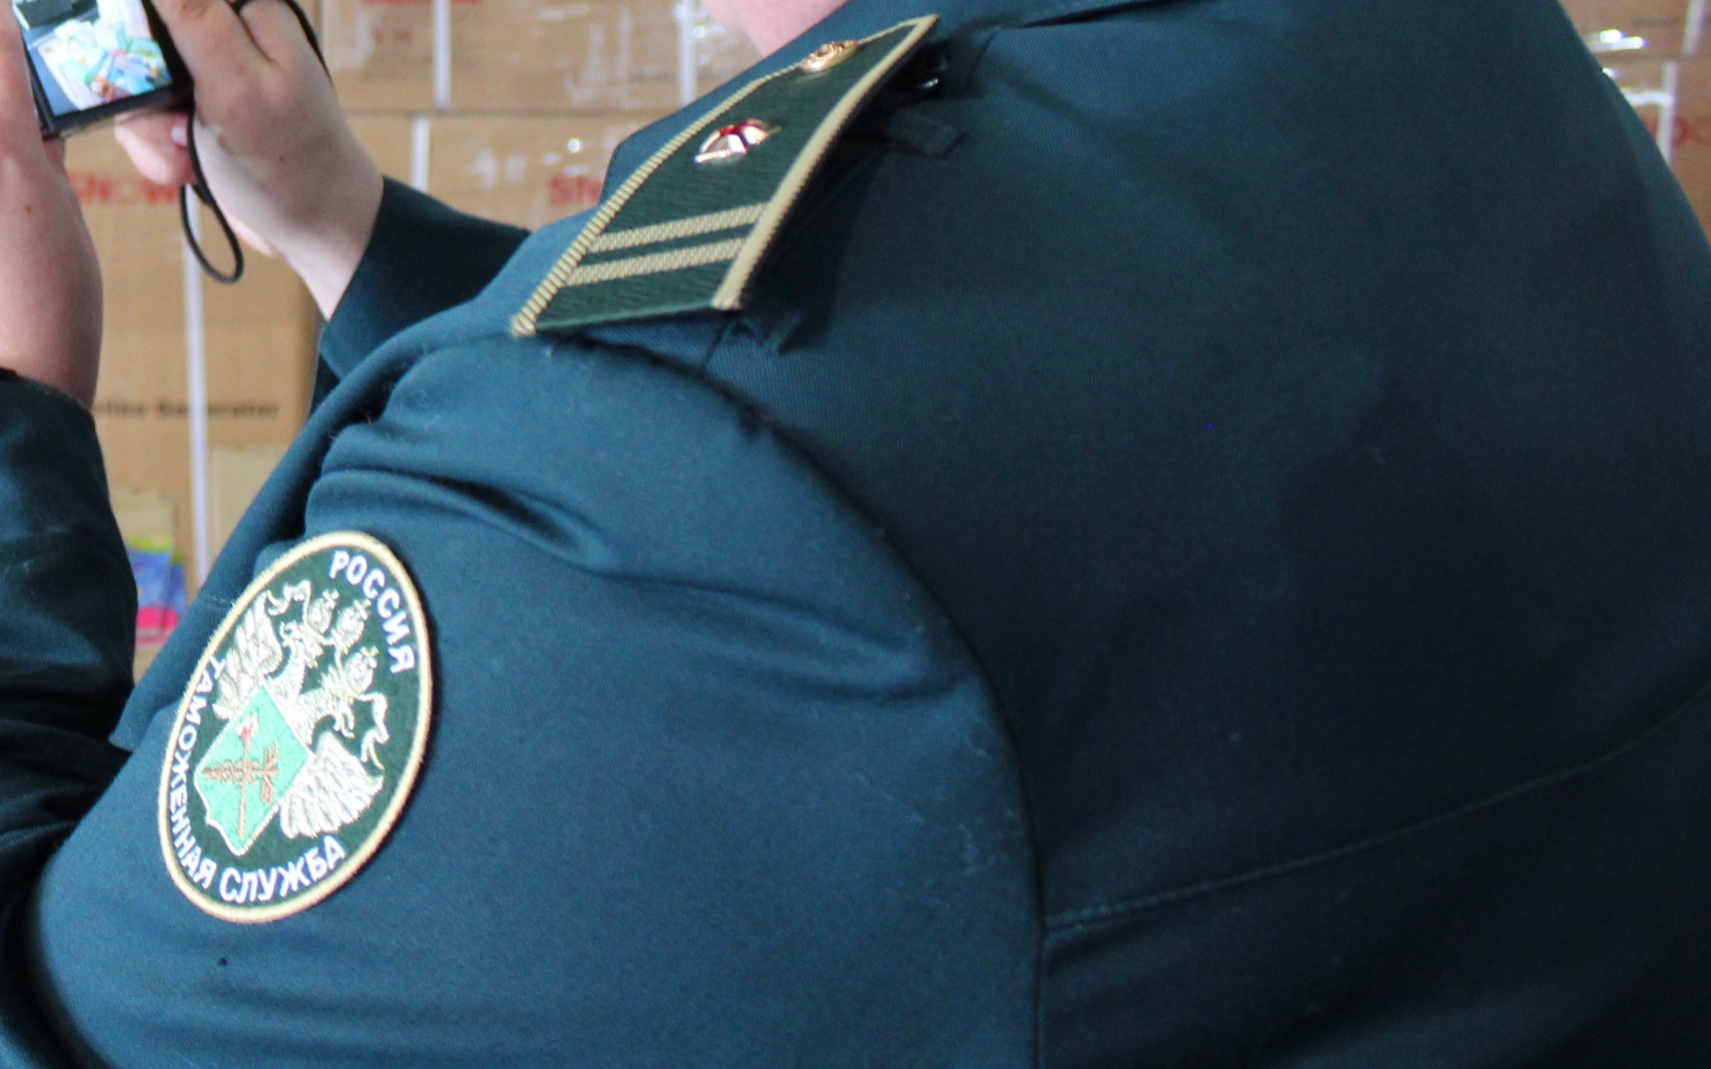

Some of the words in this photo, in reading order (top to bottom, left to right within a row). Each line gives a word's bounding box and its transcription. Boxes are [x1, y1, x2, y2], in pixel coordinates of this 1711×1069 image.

[328, 549, 415, 674] РОССИЯ
[168, 654, 227, 889] ТАМОЖЕННАЯ
[219, 834, 348, 904] СЛУЖБА
